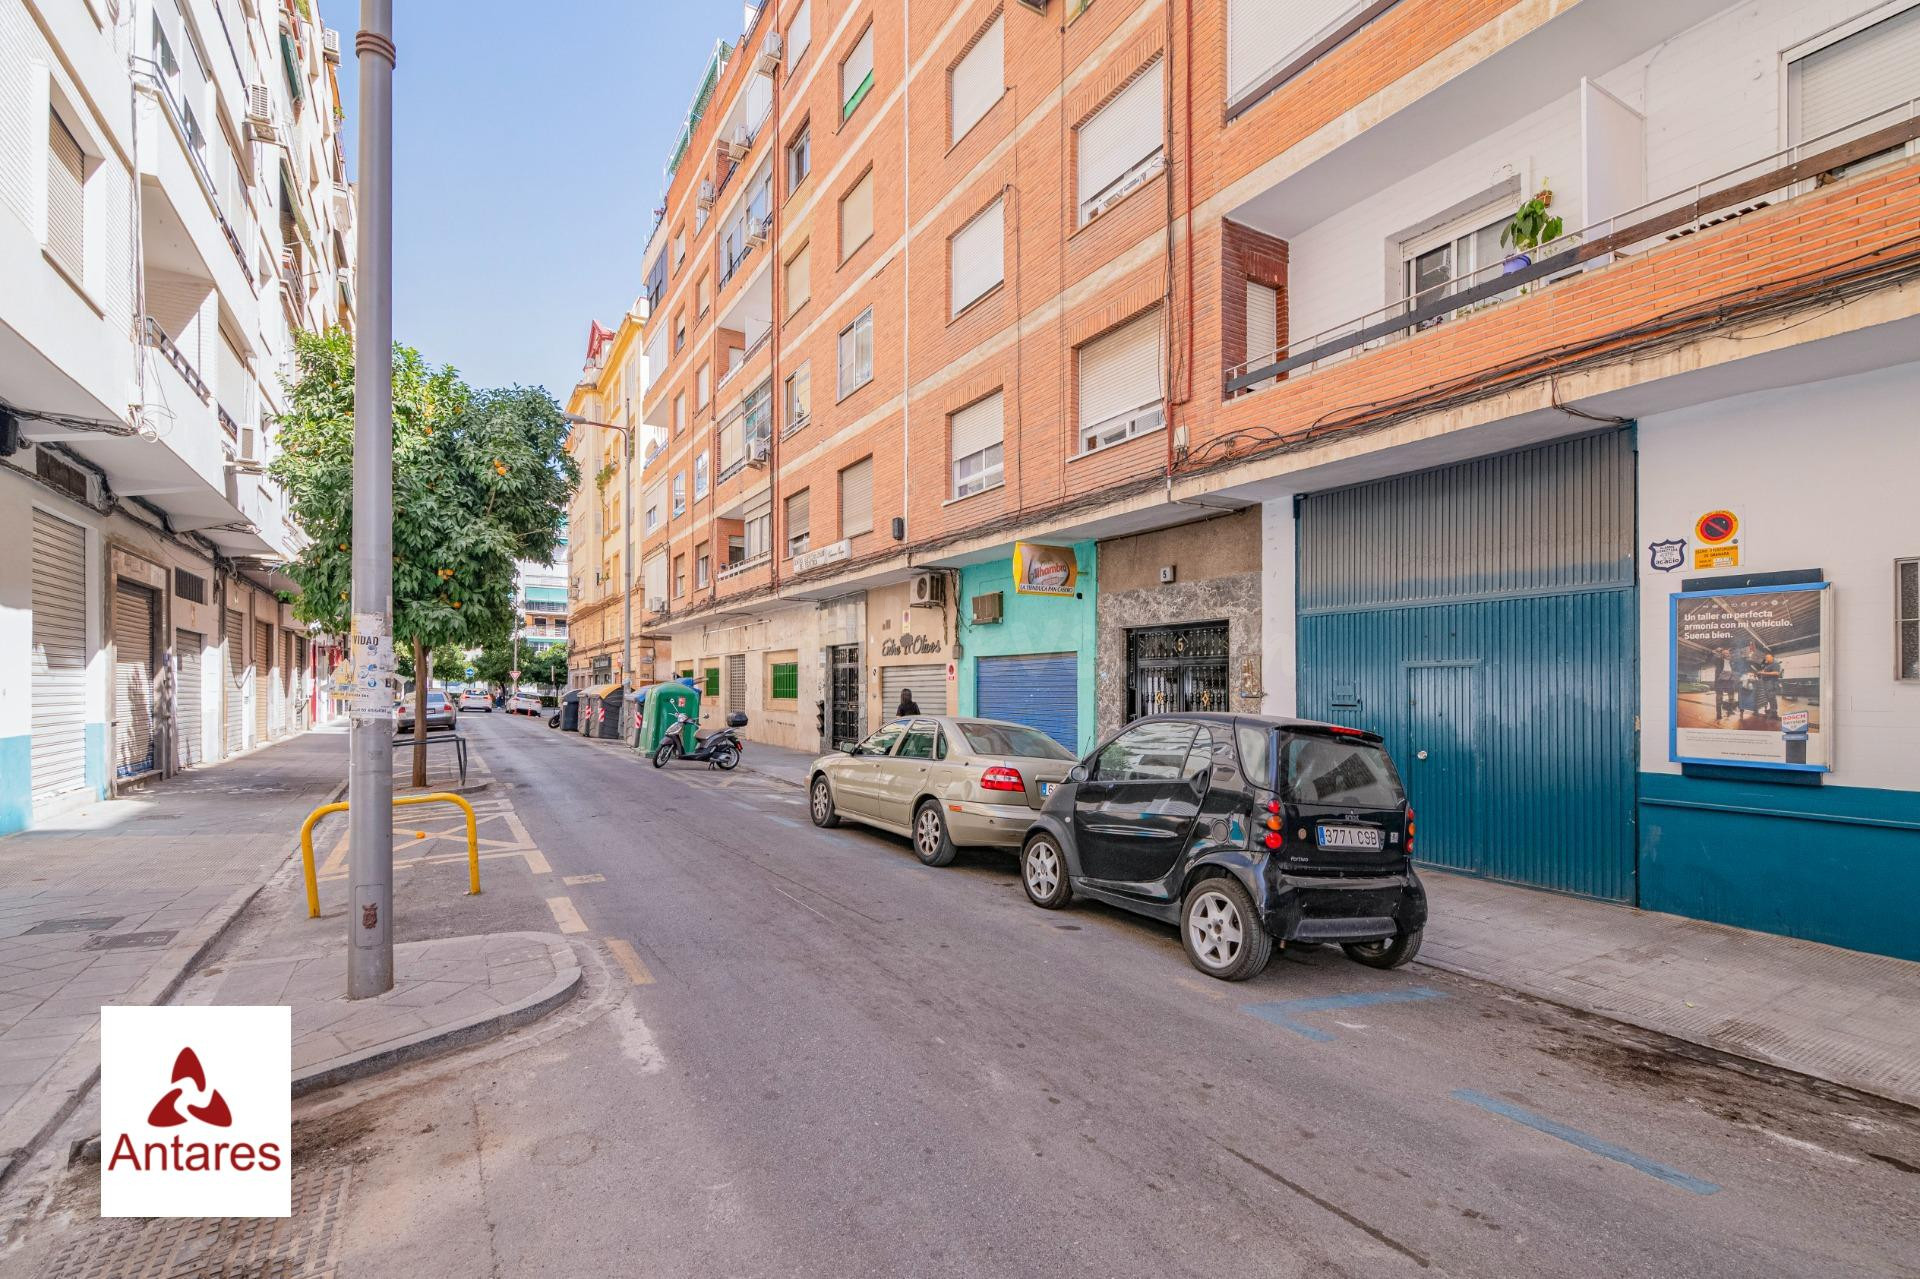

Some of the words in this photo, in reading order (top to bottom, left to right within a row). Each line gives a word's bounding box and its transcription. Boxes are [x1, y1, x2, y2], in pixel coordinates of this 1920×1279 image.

[1162, 570, 1167, 579] 5
[1684, 613, 1696, 621] Un
[1698, 611, 1719, 620] taller
[1721, 612, 1732, 620] en
[1734, 610, 1773, 620] perfecta
[1684, 622, 1718, 631] armonía
[1720, 621, 1736, 629] con
[1738, 619, 1749, 628] mi
[1751, 618, 1793, 628] vehículo.
[1684, 632, 1710, 640] Suena
[1711, 631, 1733, 639] bien.
[1325, 828, 1353, 844] 3771
